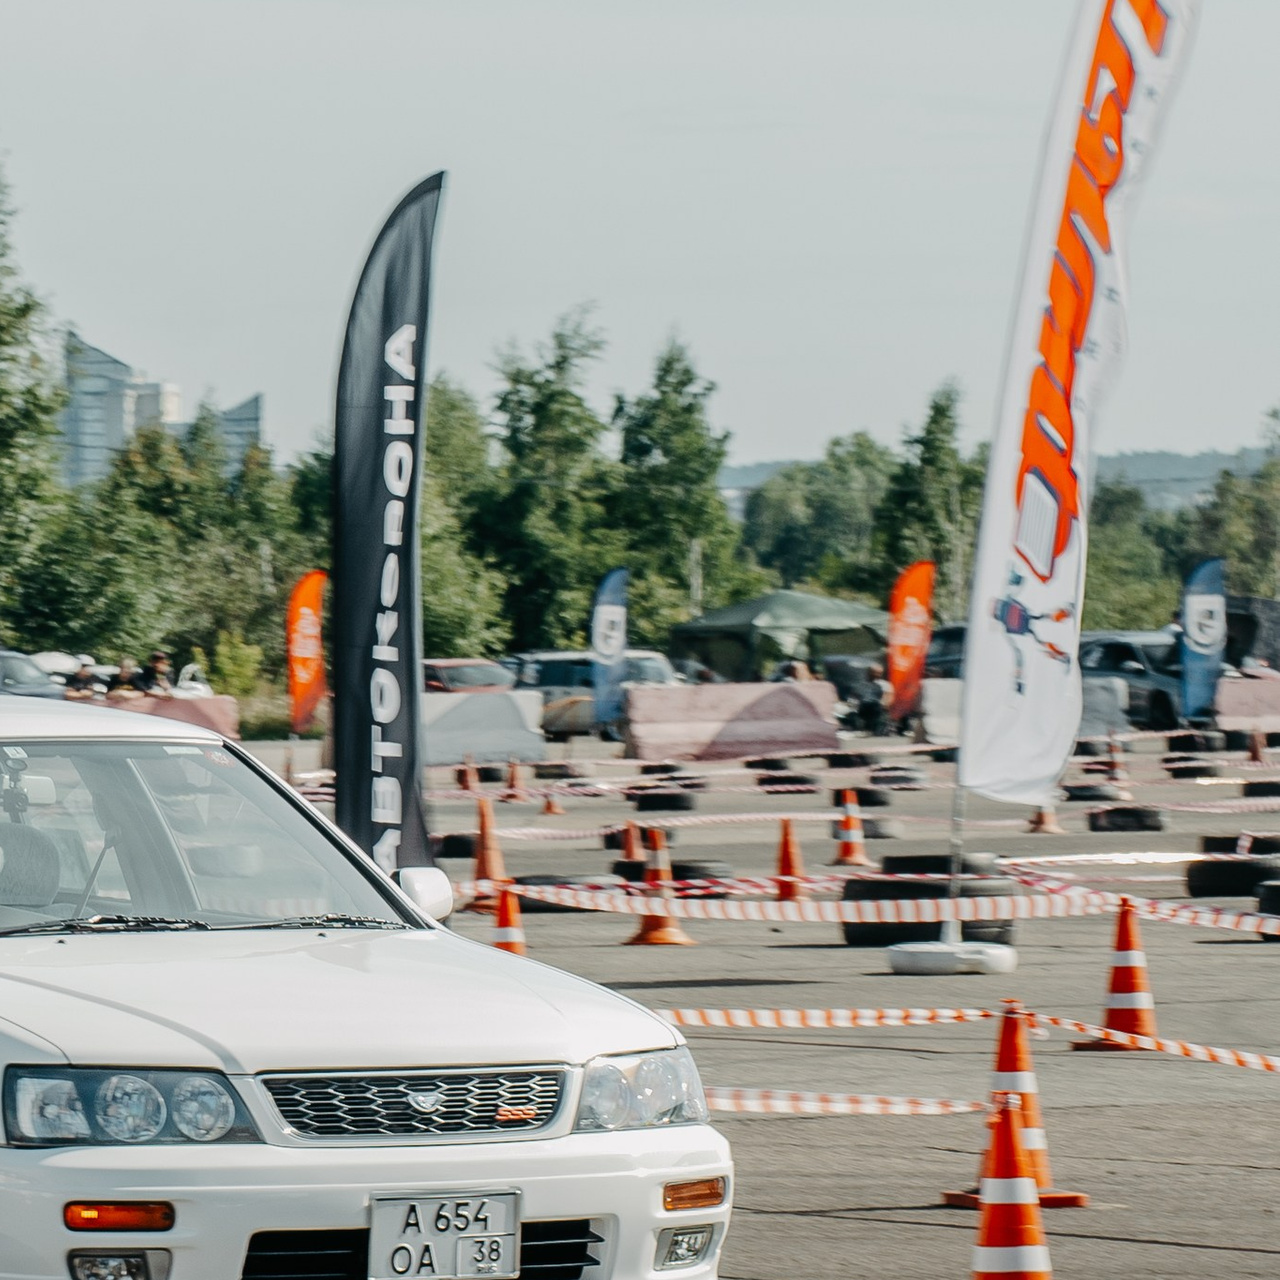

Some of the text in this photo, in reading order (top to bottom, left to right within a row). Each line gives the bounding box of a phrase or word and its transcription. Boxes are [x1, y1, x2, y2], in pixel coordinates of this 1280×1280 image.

[370, 323, 417, 873] АВТОКОРОНА
[495, 1106, 538, 1120] SSS
[434, 1198, 491, 1233] 654
[472, 1237, 504, 1263] 38
